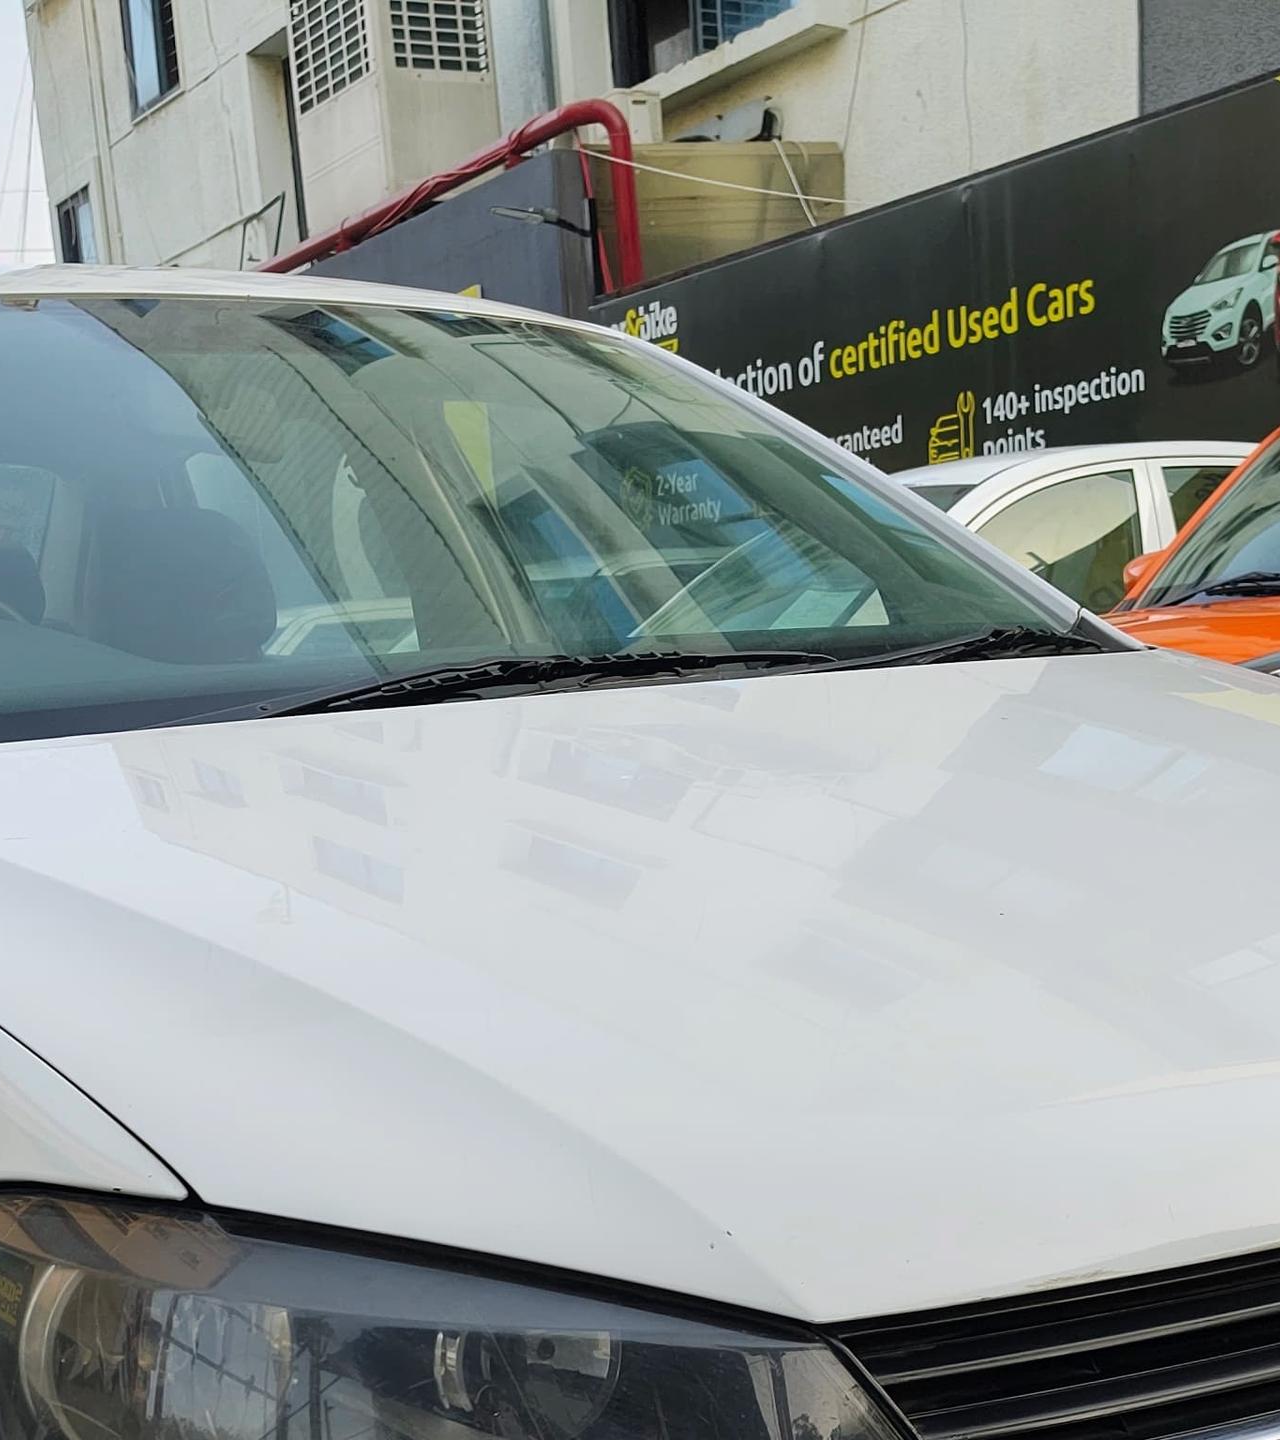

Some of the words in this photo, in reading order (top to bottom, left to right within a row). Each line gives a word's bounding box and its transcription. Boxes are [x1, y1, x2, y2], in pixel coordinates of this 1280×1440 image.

[797, 340, 826, 387] of
[828, 308, 941, 379] certified
[946, 286, 1019, 349] Used
[1026, 278, 1096, 327] Cars
[981, 394, 1031, 425] 140+
[1034, 366, 1146, 415] inspection
[657, 497, 721, 525] Warranty
